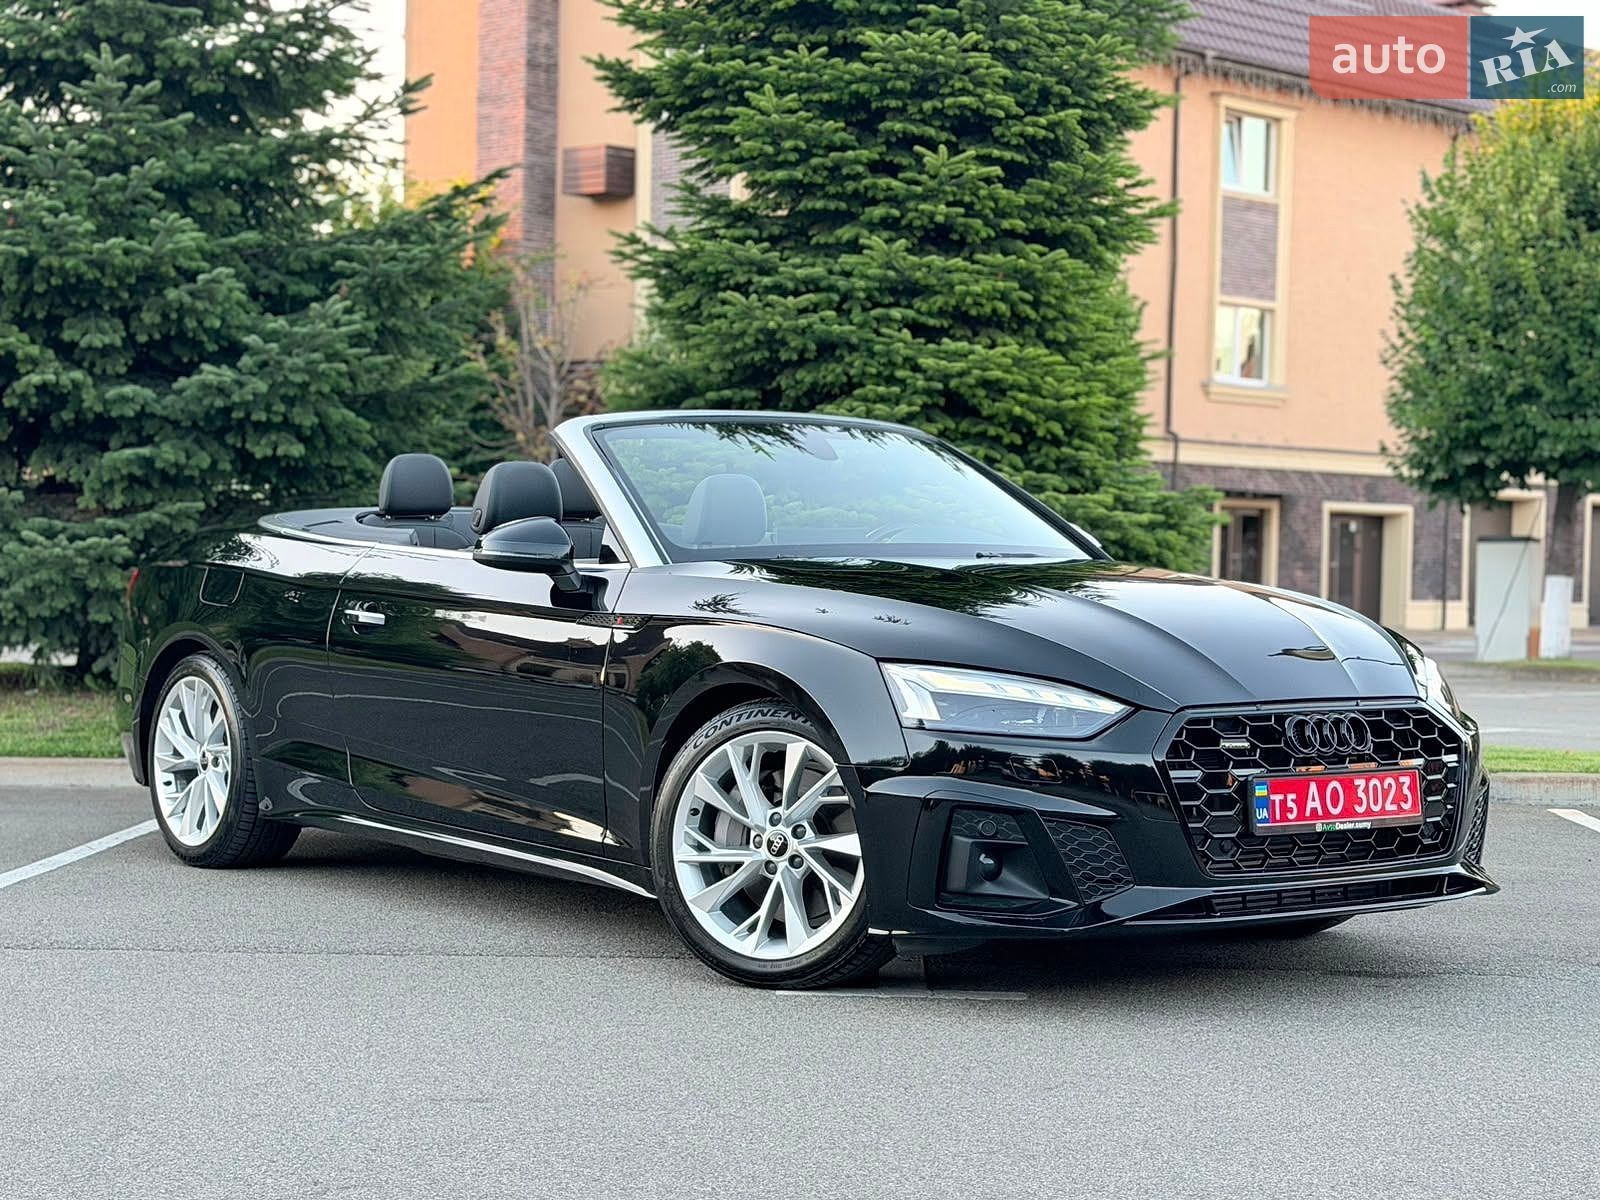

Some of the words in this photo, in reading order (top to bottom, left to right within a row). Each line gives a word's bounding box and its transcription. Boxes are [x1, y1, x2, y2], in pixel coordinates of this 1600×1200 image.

[1270, 793, 1298, 820] T5
[1305, 780, 1345, 817] AO
[1353, 776, 1413, 814] 3023
[1256, 807, 1269, 820] UA
